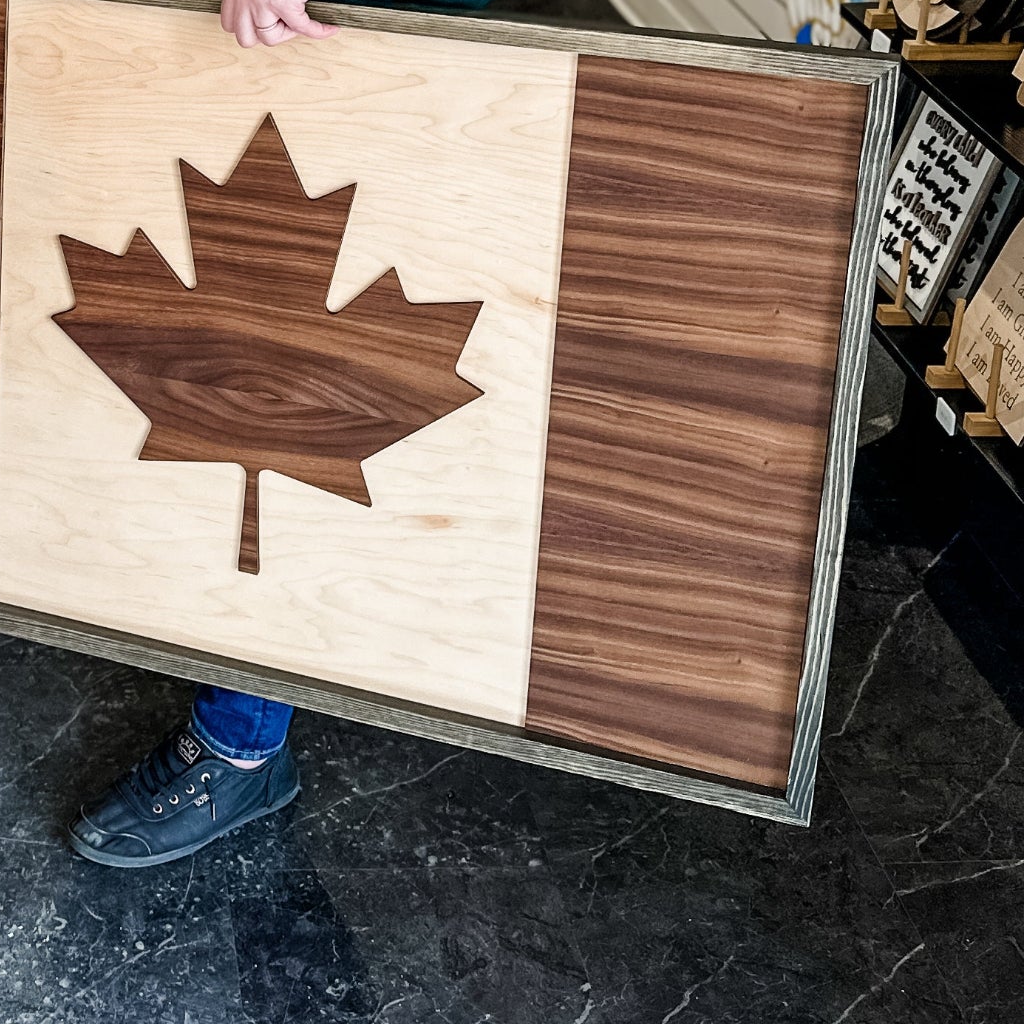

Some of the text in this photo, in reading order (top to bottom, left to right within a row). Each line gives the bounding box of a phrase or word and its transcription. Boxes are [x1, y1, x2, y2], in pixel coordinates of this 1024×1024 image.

[997, 300, 1014, 321] am
[985, 326, 1002, 345] am
[971, 353, 988, 375] am
